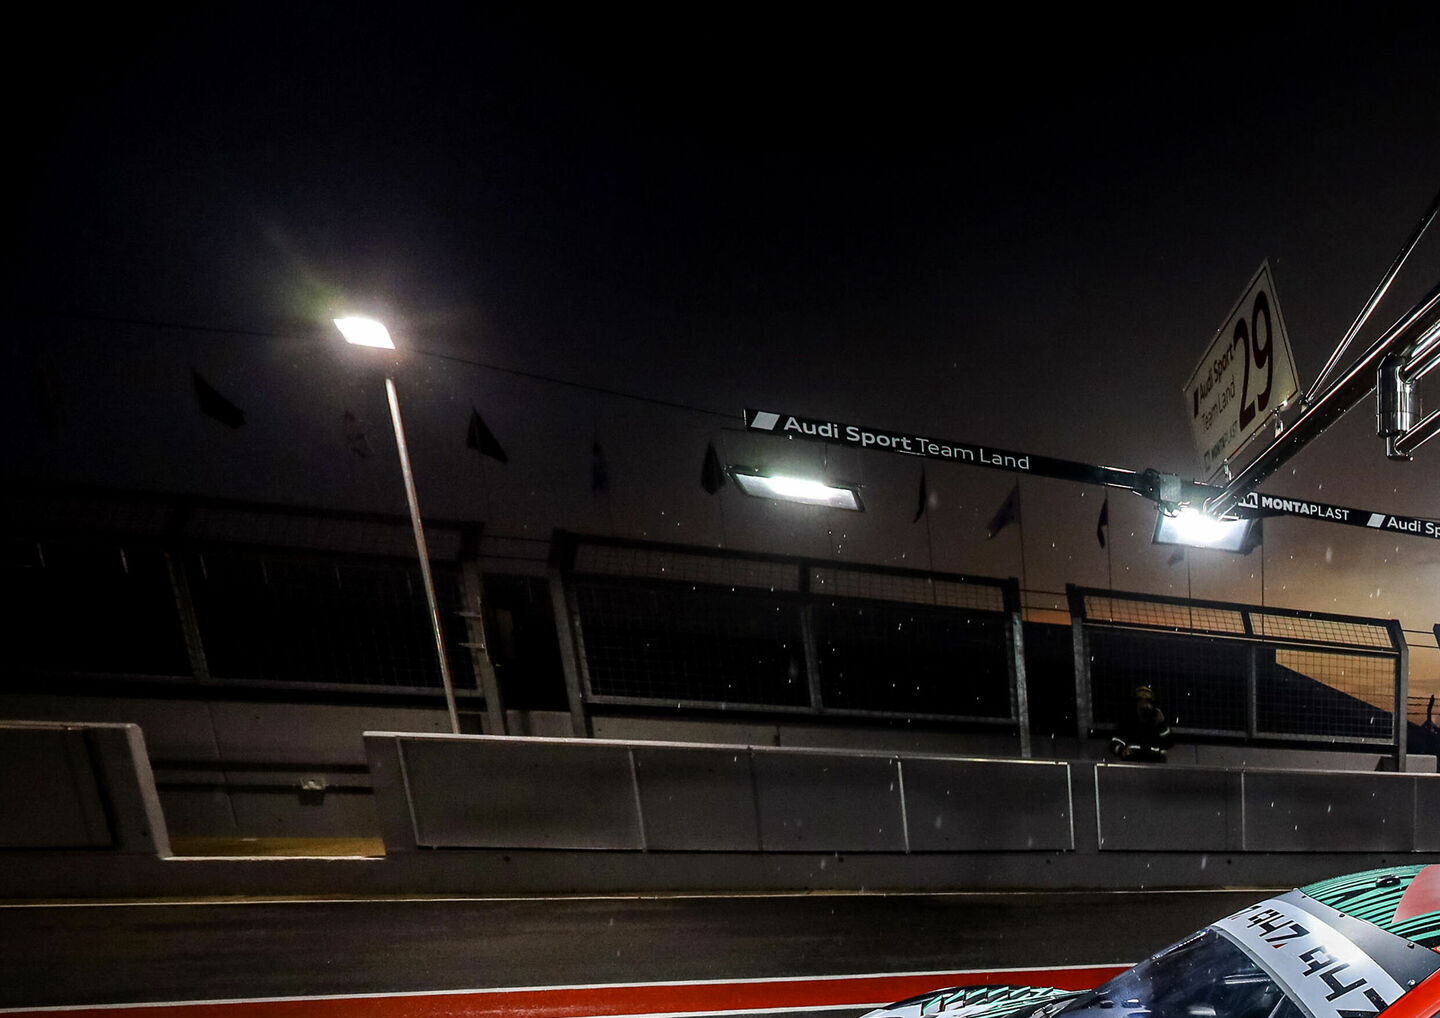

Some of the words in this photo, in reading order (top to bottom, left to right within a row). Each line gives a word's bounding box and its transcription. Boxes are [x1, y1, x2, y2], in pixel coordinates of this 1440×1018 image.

[1214, 343, 1234, 384] Sport
[1233, 290, 1273, 432] 29
[1218, 375, 1236, 420] Land
[784, 417, 839, 439] Audi
[846, 426, 912, 450] Sport
[915, 437, 974, 461] Team
[980, 448, 1030, 470] Land
[1261, 496, 1350, 521] MONTAPLAST
[1386, 516, 1421, 533] Audi
